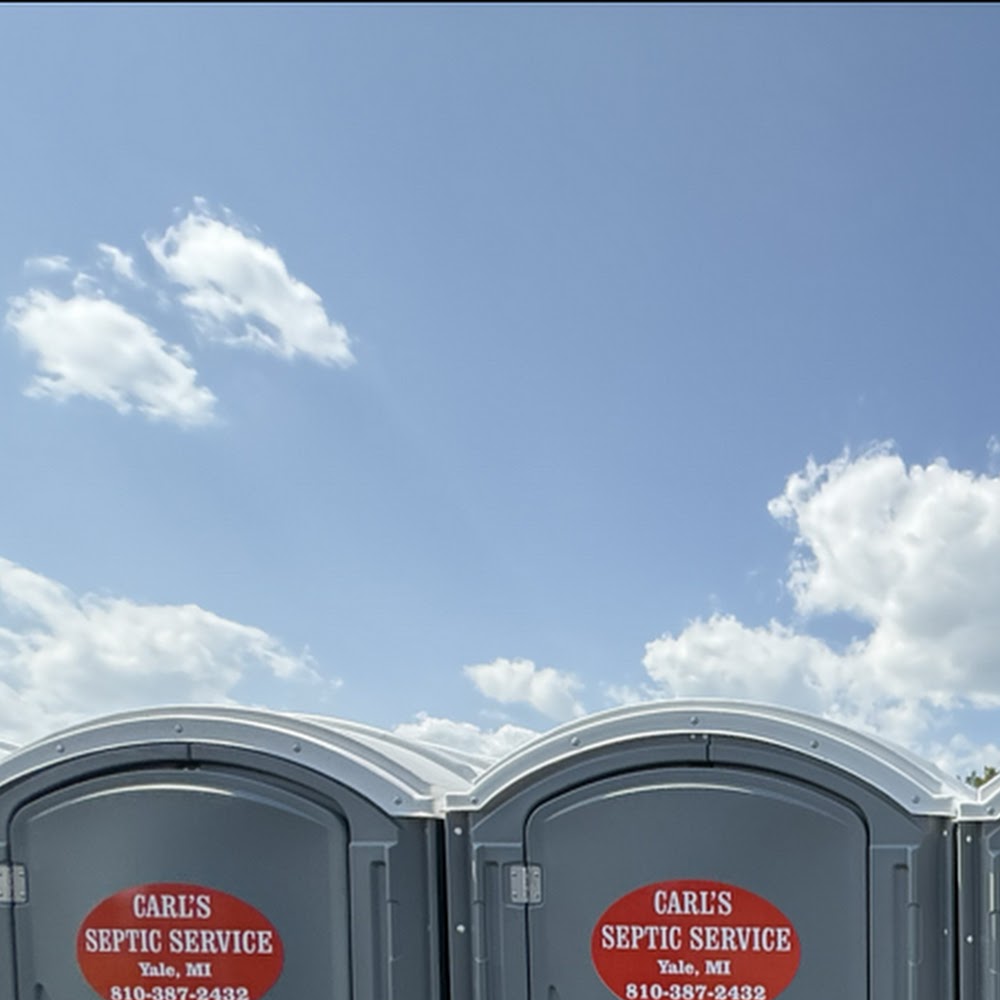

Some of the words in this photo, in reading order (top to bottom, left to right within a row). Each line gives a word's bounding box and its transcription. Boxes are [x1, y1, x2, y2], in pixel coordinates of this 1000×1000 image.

[133, 893, 212, 919] CARL'S
[654, 889, 733, 916] CARL'S
[84, 928, 162, 954] SEPTIC
[168, 928, 273, 954] SERVICE
[601, 924, 682, 951] SEPTIC
[689, 925, 792, 952] SERVICE
[137, 961, 181, 979] Yale,
[185, 962, 212, 977] MI
[657, 959, 700, 977] Yale,
[705, 959, 731, 976] MI
